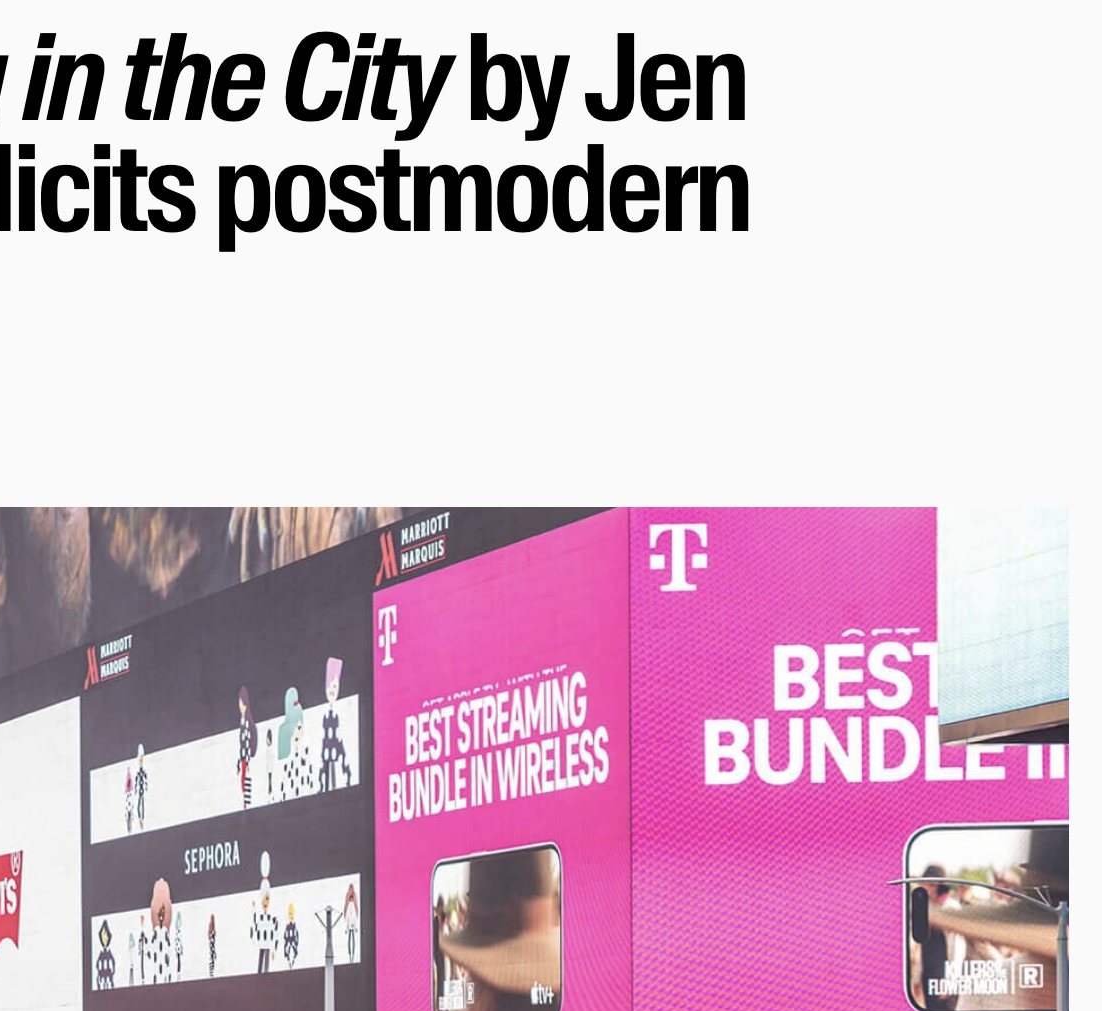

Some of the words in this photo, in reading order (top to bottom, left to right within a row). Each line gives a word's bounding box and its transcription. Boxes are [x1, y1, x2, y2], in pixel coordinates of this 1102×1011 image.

[401, 512, 450, 545] MARRIOTT
[401, 539, 445, 570] MARQUIS
[100, 634, 133, 658] MARRIOTT
[100, 655, 129, 679] MARQUIS
[773, 642, 938, 711] BEST
[406, 705, 454, 766] BEST
[457, 671, 587, 754] STREAMING
[389, 757, 467, 823] BUNDLE
[471, 752, 492, 808] IN
[496, 725, 609, 801] WIRELESS
[184, 841, 240, 875] SEPHORA
